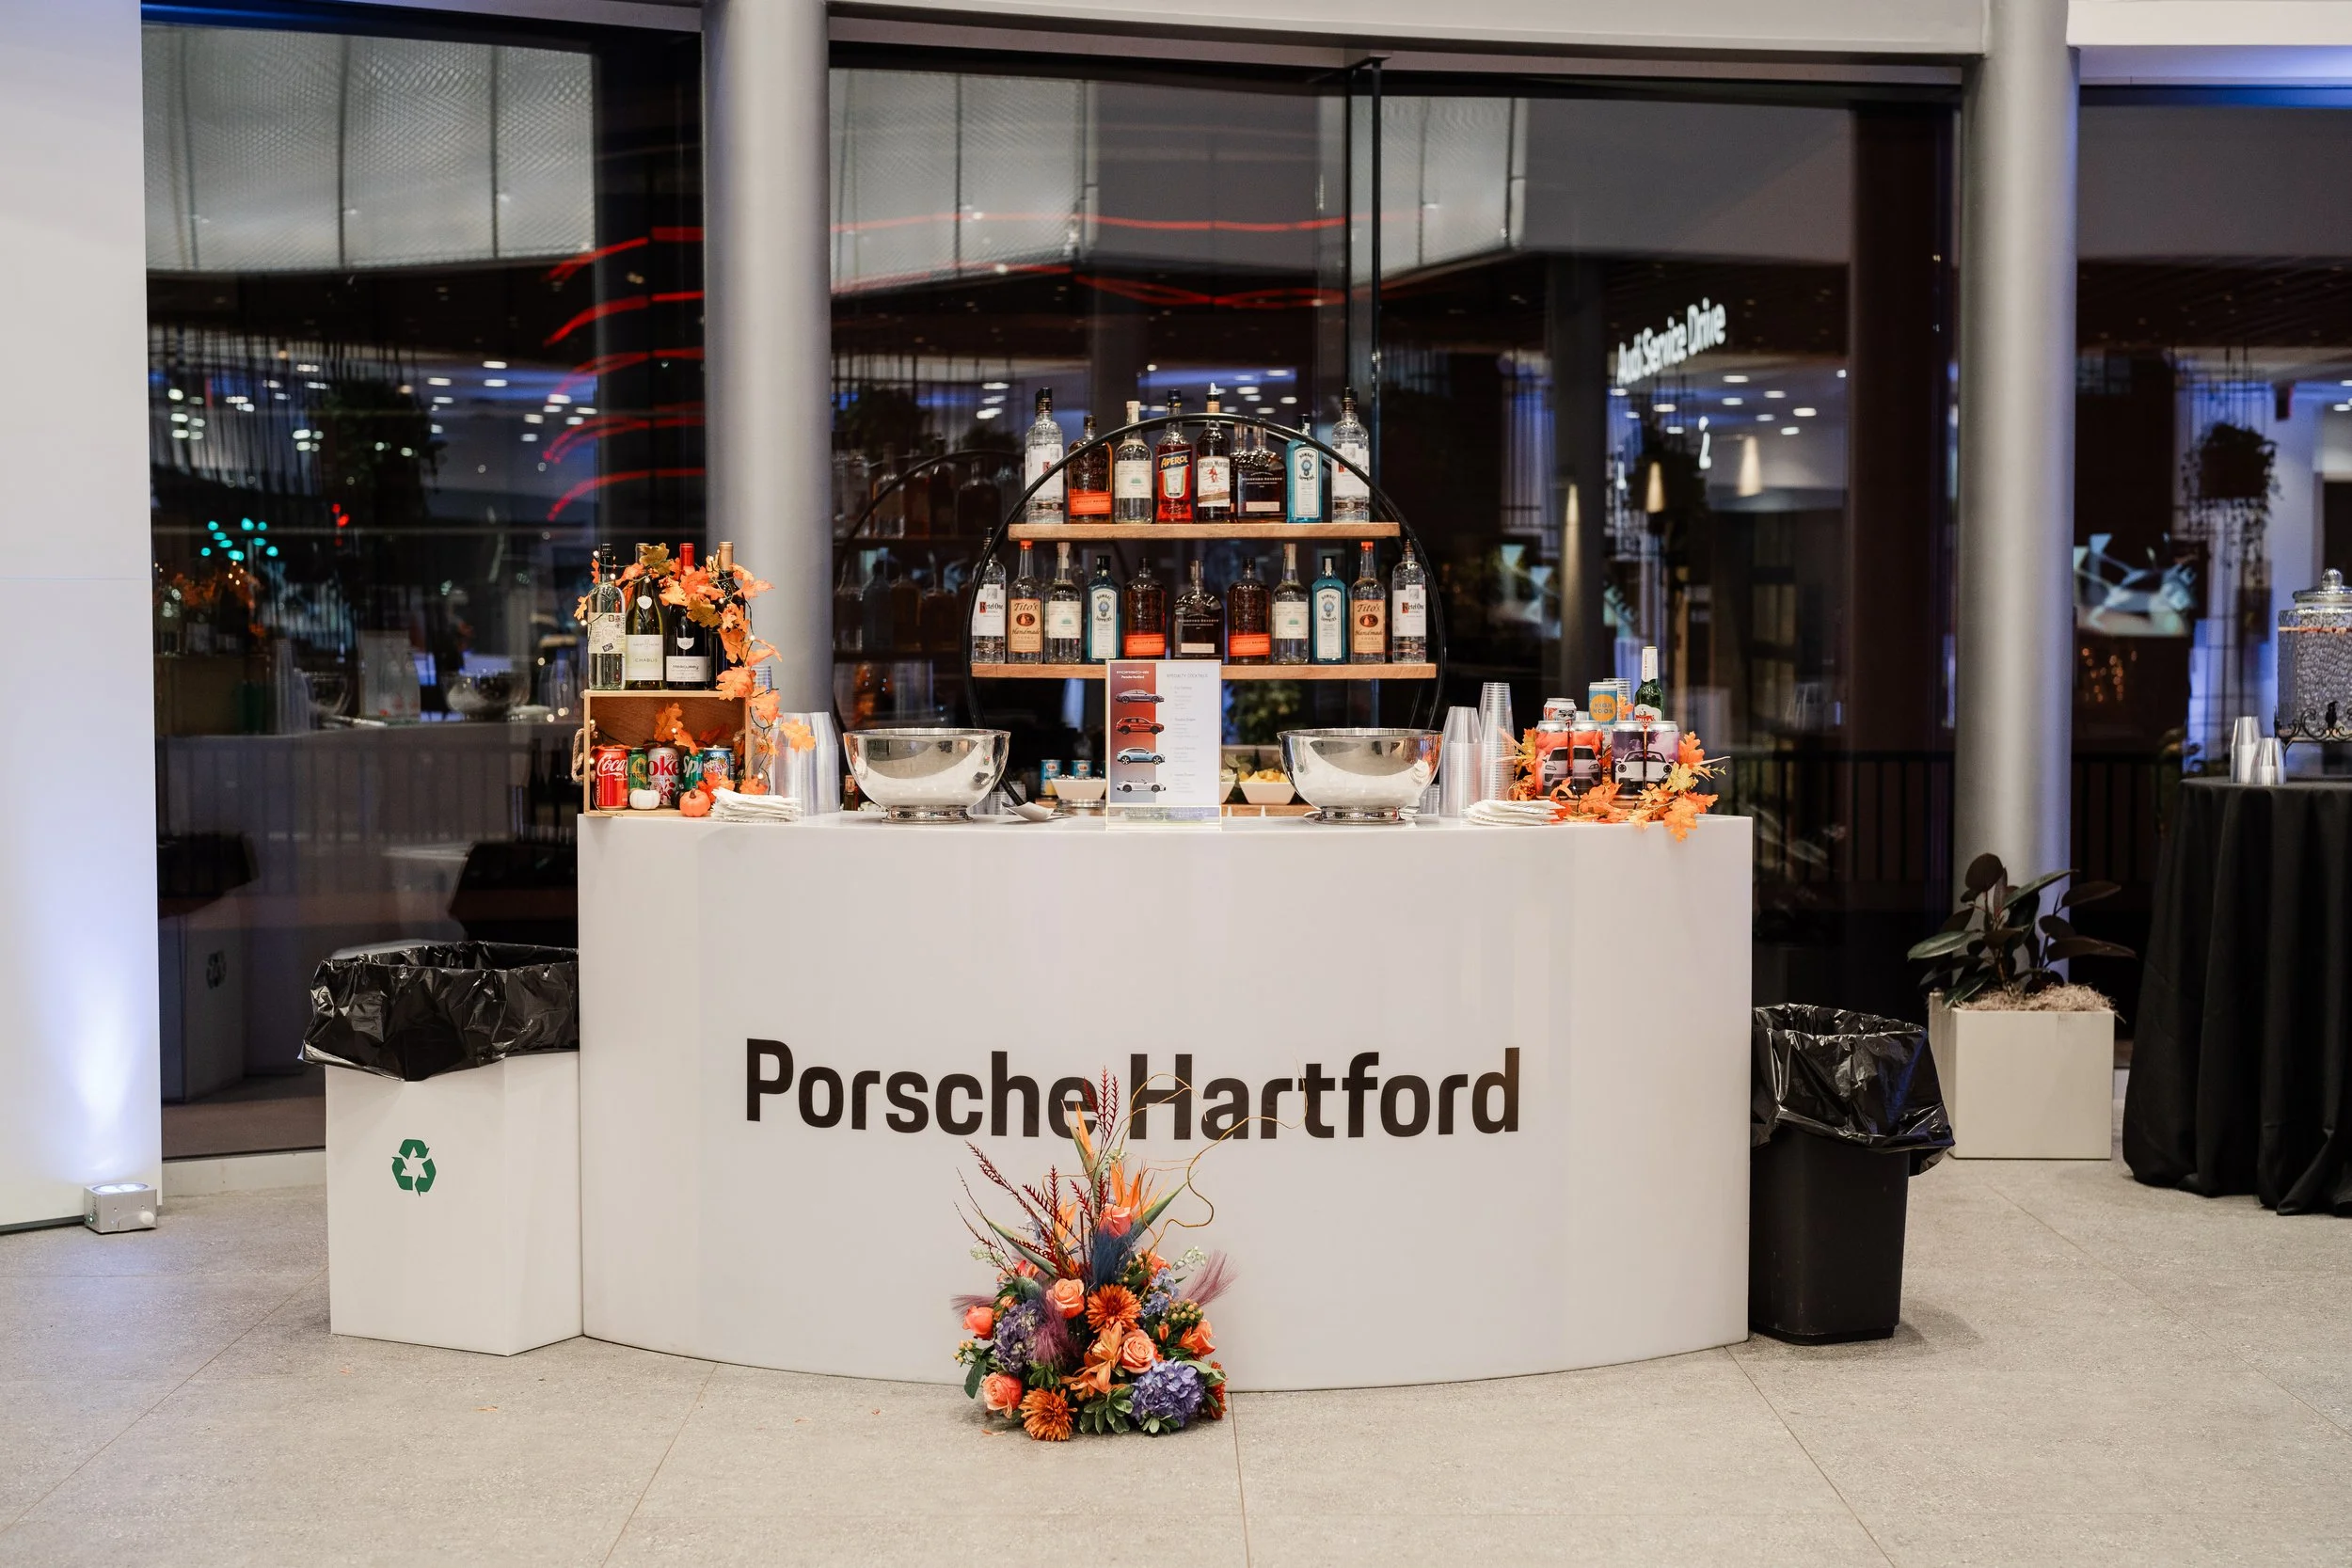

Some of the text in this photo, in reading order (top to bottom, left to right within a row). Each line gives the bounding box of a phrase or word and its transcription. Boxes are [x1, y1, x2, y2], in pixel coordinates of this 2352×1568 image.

[1687, 296, 1726, 356] Drive
[1161, 455, 1188, 468] APEROL
[1014, 602, 1038, 611] Tito's
[1357, 603, 1381, 612] Tito's
[596, 753, 628, 777] Coca
[647, 754, 679, 777] oke
[746, 1037, 1520, 1141] Porsche Hartford
